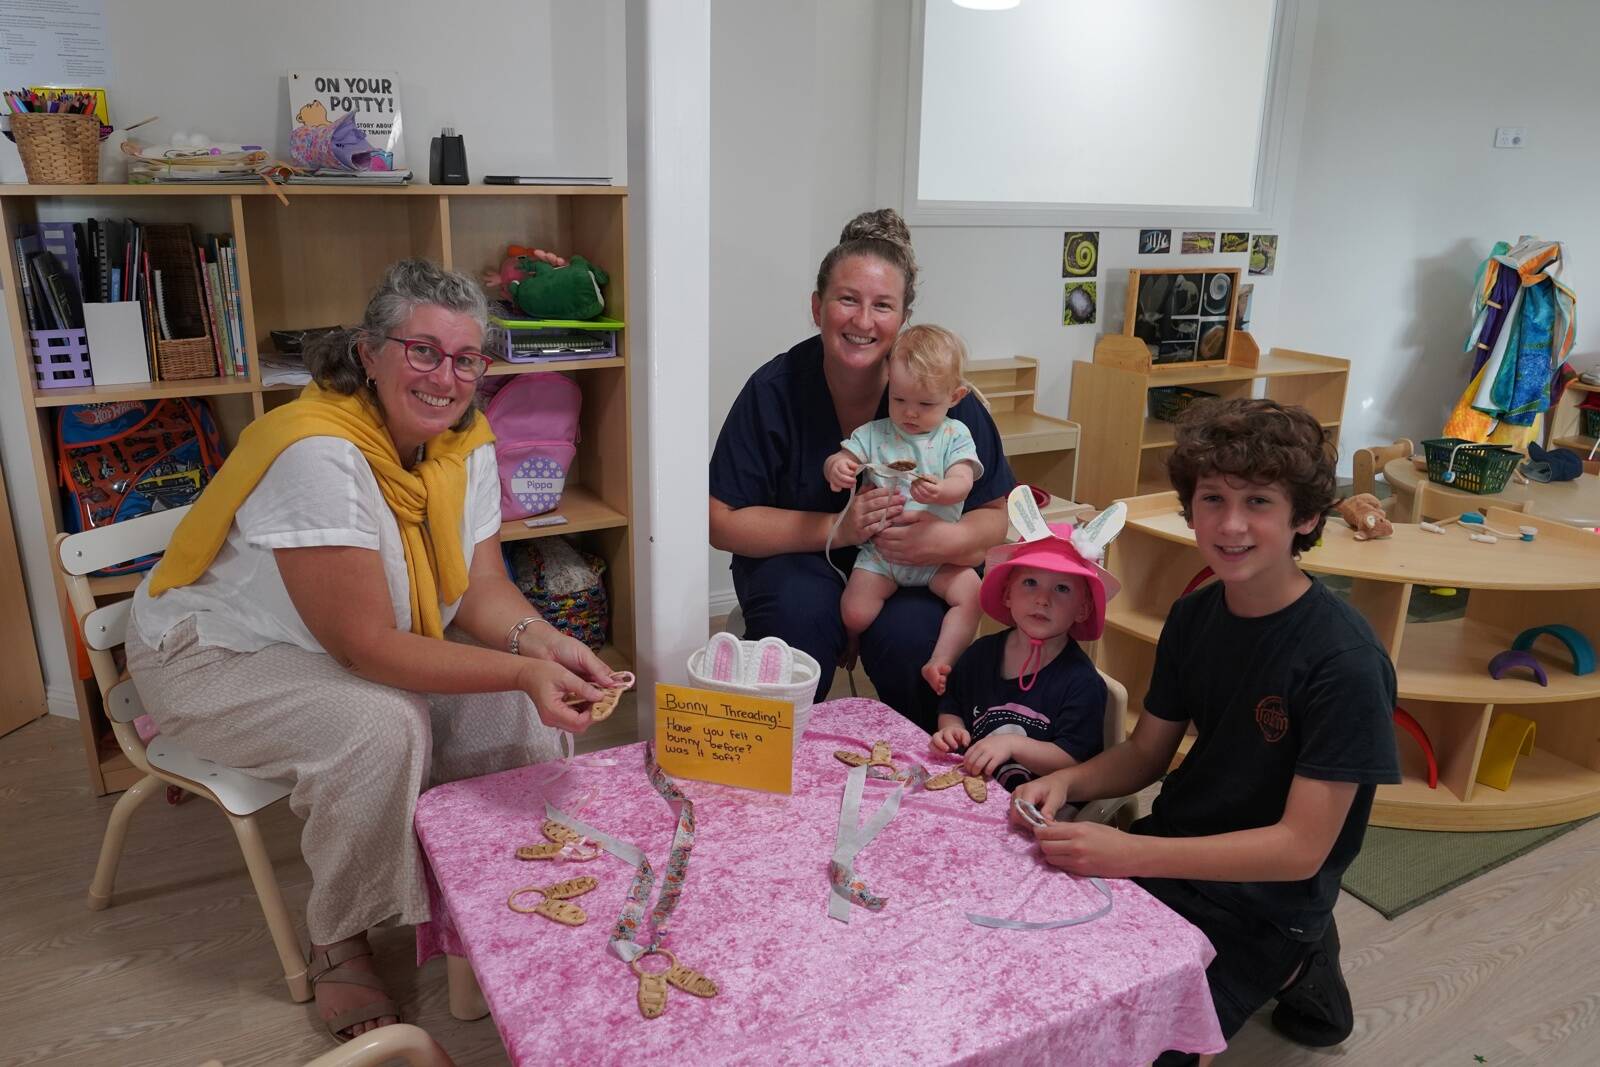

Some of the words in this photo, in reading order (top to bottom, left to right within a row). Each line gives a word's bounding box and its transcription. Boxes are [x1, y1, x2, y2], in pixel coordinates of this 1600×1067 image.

[314, 77, 340, 93] ON
[344, 78, 393, 94] YOUR
[330, 96, 394, 113] POTTY!
[96, 407, 112, 423] HOT
[527, 481, 552, 490] Pippa
[665, 693, 708, 716] Bunny
[720, 703, 782, 730] Threading!
[666, 717, 692, 734] Have
[703, 727, 724, 743] you
[730, 729, 748, 741] felt
[755, 735, 763, 743] a
[666, 732, 700, 749] bunny
[710, 741, 752, 754] before?
[697, 749, 704, 757] it
